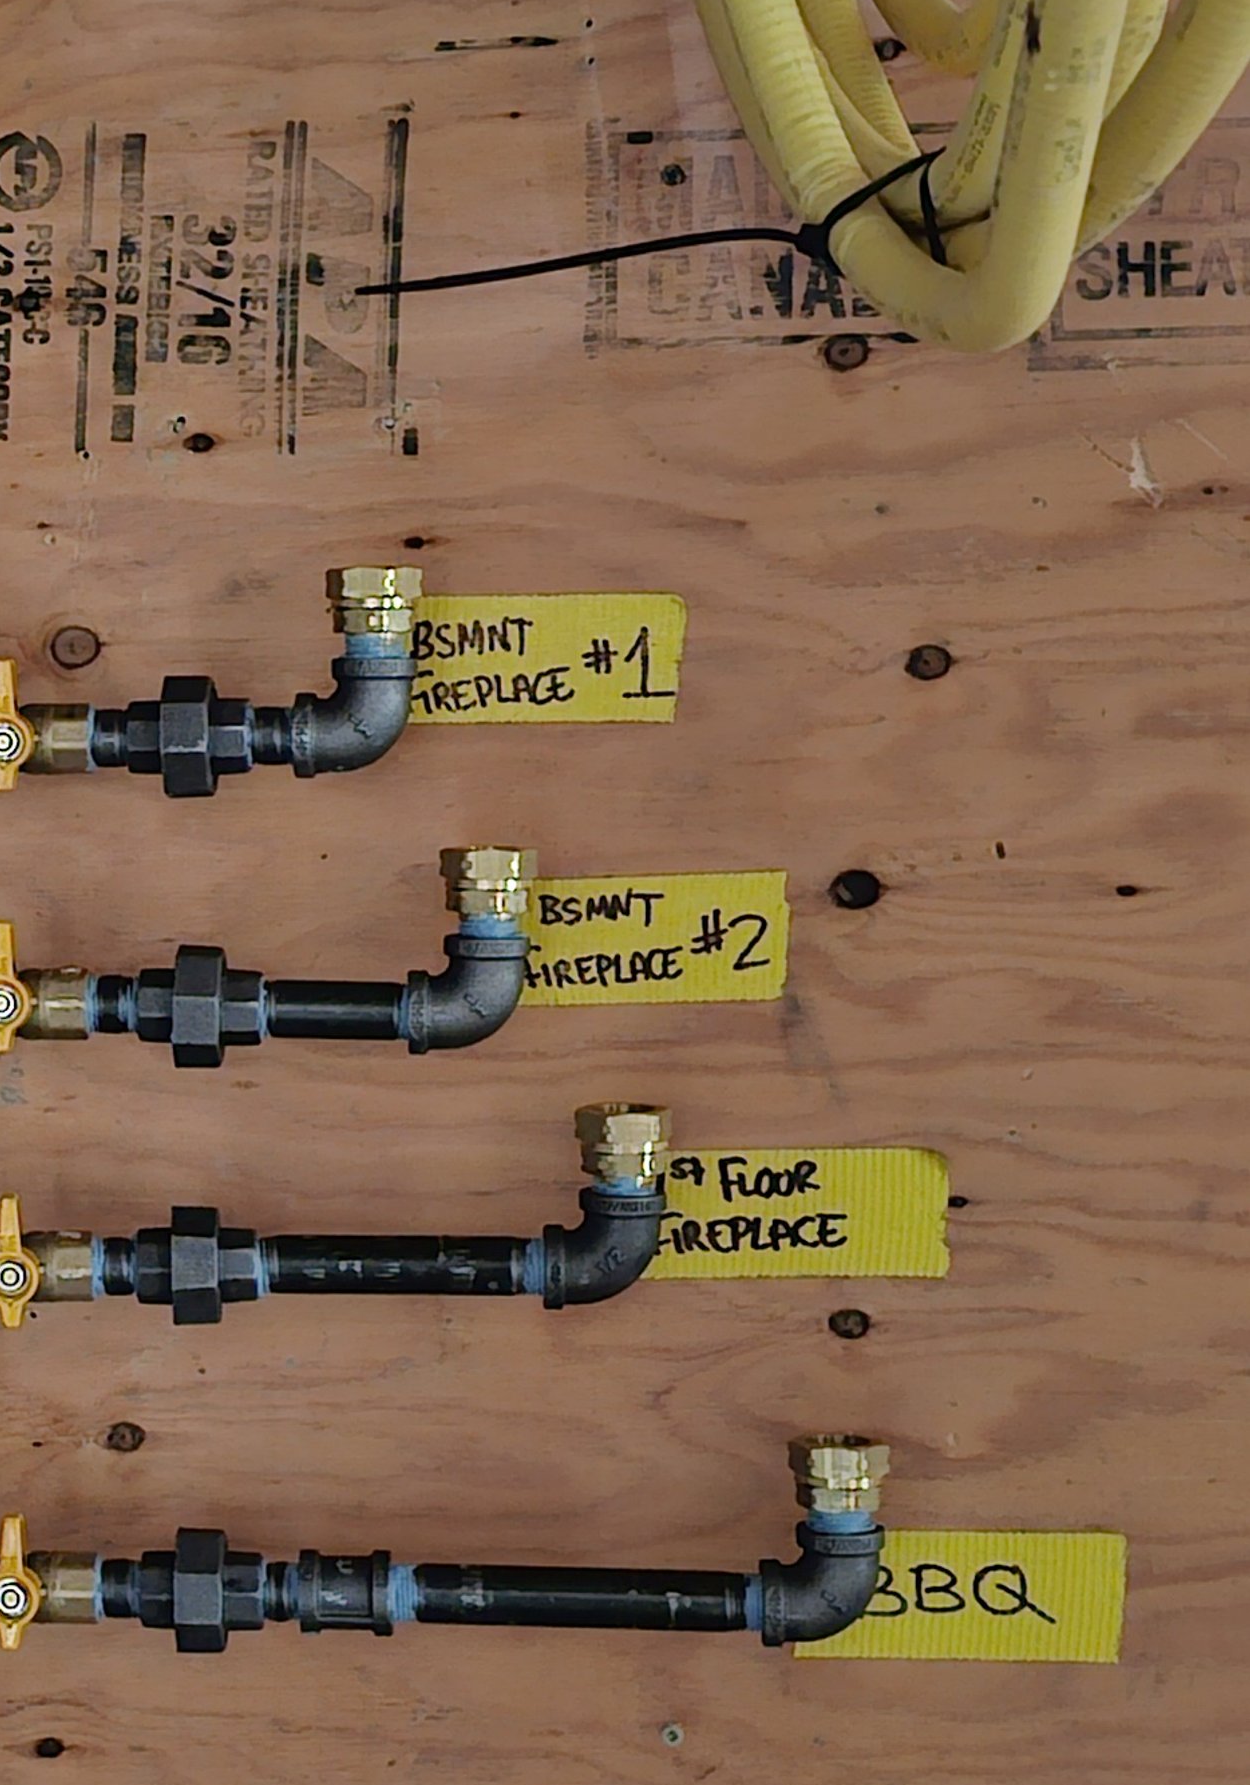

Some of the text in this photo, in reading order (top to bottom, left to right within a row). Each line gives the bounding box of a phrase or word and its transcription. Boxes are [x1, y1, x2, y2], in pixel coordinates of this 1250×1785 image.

[65, 247, 110, 329] 546
[176, 213, 238, 367] 32/16
[237, 139, 278, 439] RATED SHEATHING
[410, 617, 534, 659] BSMNT
[581, 626, 676, 700] #1
[537, 891, 665, 927] BSMNT
[689, 908, 773, 973] #2
[717, 1154, 822, 1203] FLOOR
[860, 1562, 1057, 1625] BBQ
